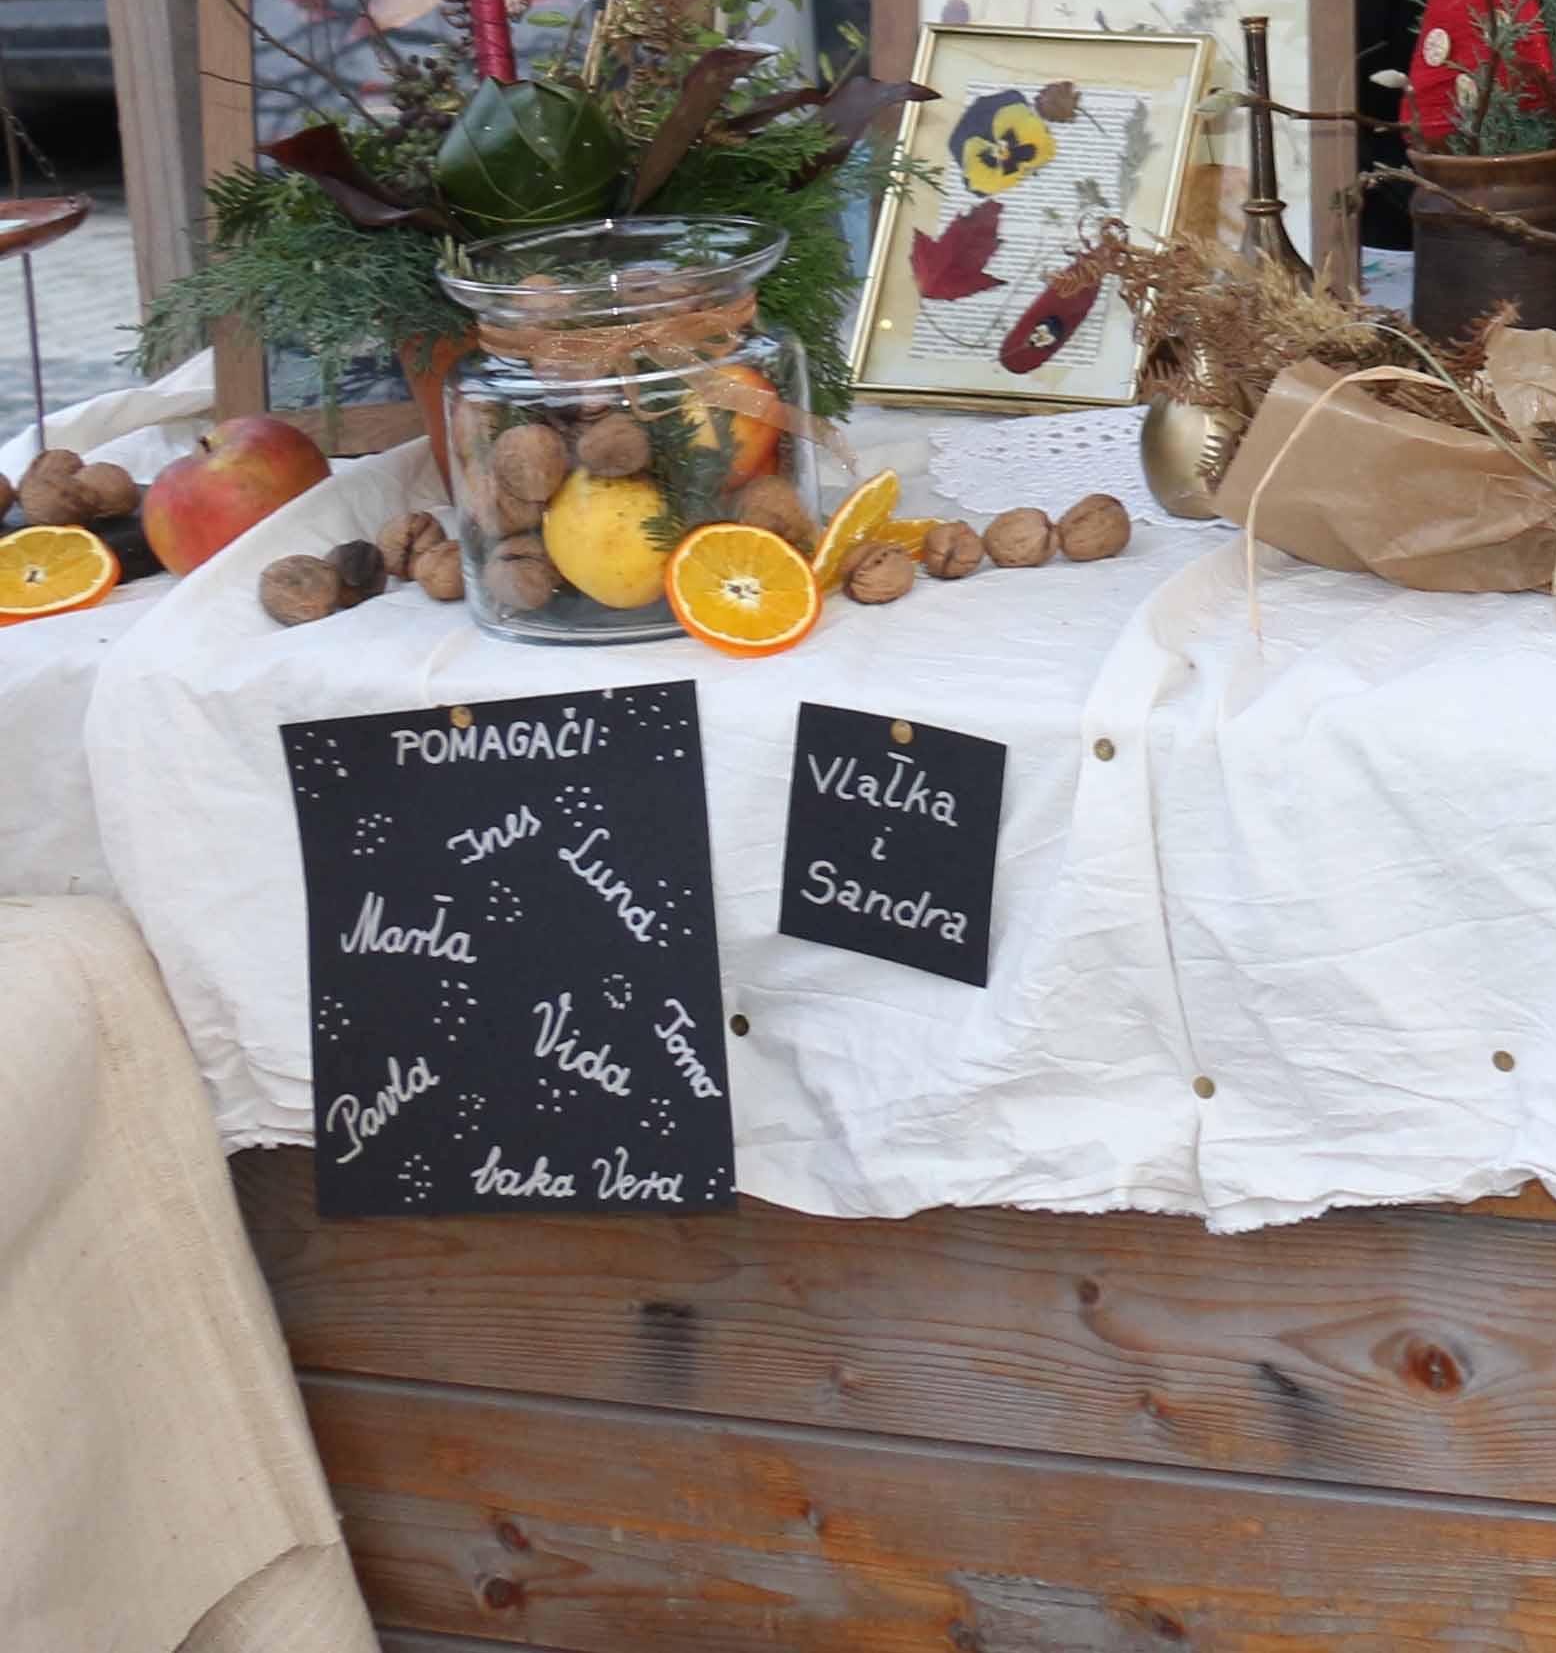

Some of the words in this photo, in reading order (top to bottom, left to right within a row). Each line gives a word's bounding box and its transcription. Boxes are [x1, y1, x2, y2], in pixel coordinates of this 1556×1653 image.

[807, 751, 959, 827] Vlatka
[446, 804, 543, 865] Ines
[870, 826, 894, 861] i
[557, 826, 657, 943] Luna
[800, 860, 969, 945] Sandra
[340, 891, 478, 964] Marta
[533, 992, 633, 1098] Vida
[326, 1056, 440, 1165] Pavla
[470, 1145, 577, 1198] baka
[592, 1146, 684, 1204] Vera
